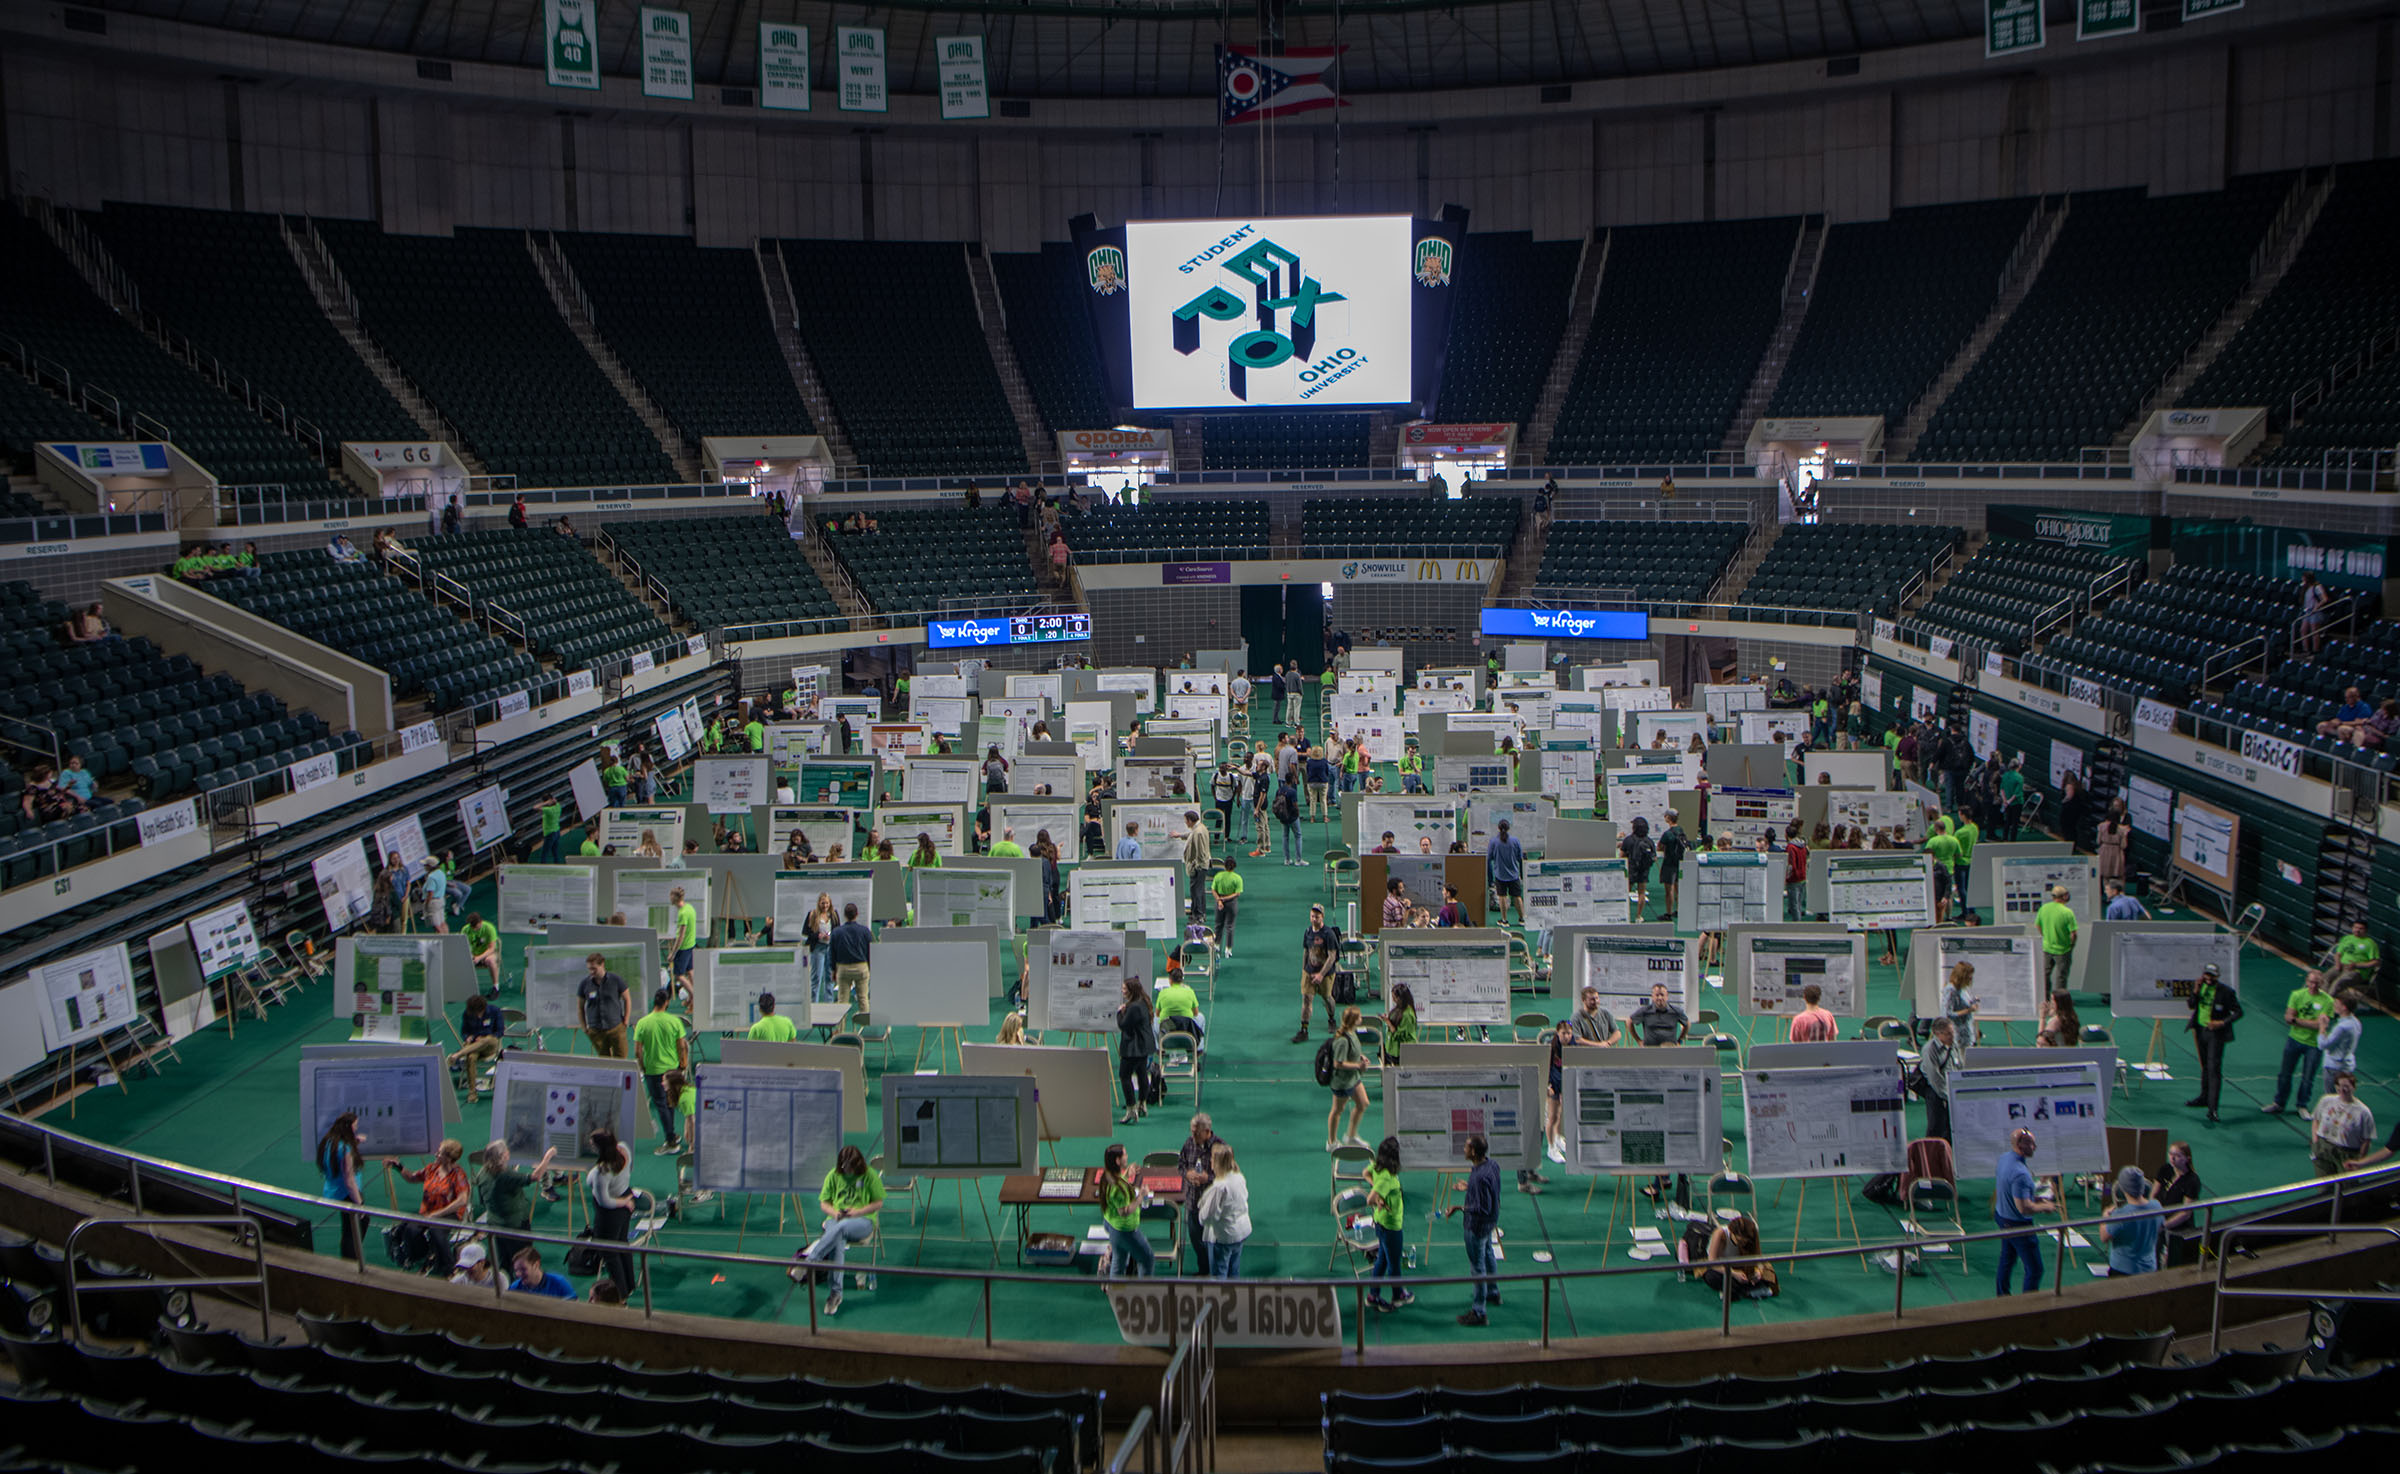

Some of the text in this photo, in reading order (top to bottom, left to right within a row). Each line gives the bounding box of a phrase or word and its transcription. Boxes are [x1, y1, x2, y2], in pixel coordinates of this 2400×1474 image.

[652, 15, 679, 35] OHIO
[560, 30, 584, 48] OHIO
[771, 30, 798, 49] OHIO
[848, 33, 874, 50] OHIO
[564, 46, 582, 63] 40
[947, 42, 973, 58] OHIO
[648, 56, 687, 67] CHAMPIONS
[765, 64, 807, 73] TOURNAMENT
[767, 72, 804, 81] CHAMPIONS
[850, 66, 874, 77] WNIT
[943, 79, 982, 88] TOURNAMENT
[1178, 224, 1256, 275] STUDENT
[1415, 240, 1452, 276] OHIO
[1089, 247, 1125, 286] OHIO
[1299, 346, 1357, 384] OHIO
[1300, 355, 1369, 400] UNIVERSITY
[1076, 432, 1154, 448] QDOBA
[403, 447, 431, 463] G G
[2251, 489, 2279, 498] RESERVED
[597, 502, 632, 510] RESERVED
[323, 519, 349, 528] RESERVED
[2036, 518, 2063, 536] OHIO
[2071, 523, 2111, 544] BOBCAT
[26, 543, 69, 555] RESERVED
[1361, 563, 1406, 574] SNOWVILLE
[2287, 543, 2383, 578] HOME OF OHIO
[1018, 624, 1026, 635] 0
[1075, 621, 1083, 632] 0
[1039, 617, 1063, 629] 2:00
[1552, 610, 1596, 636] Kroger
[958, 620, 1000, 644] Kroger
